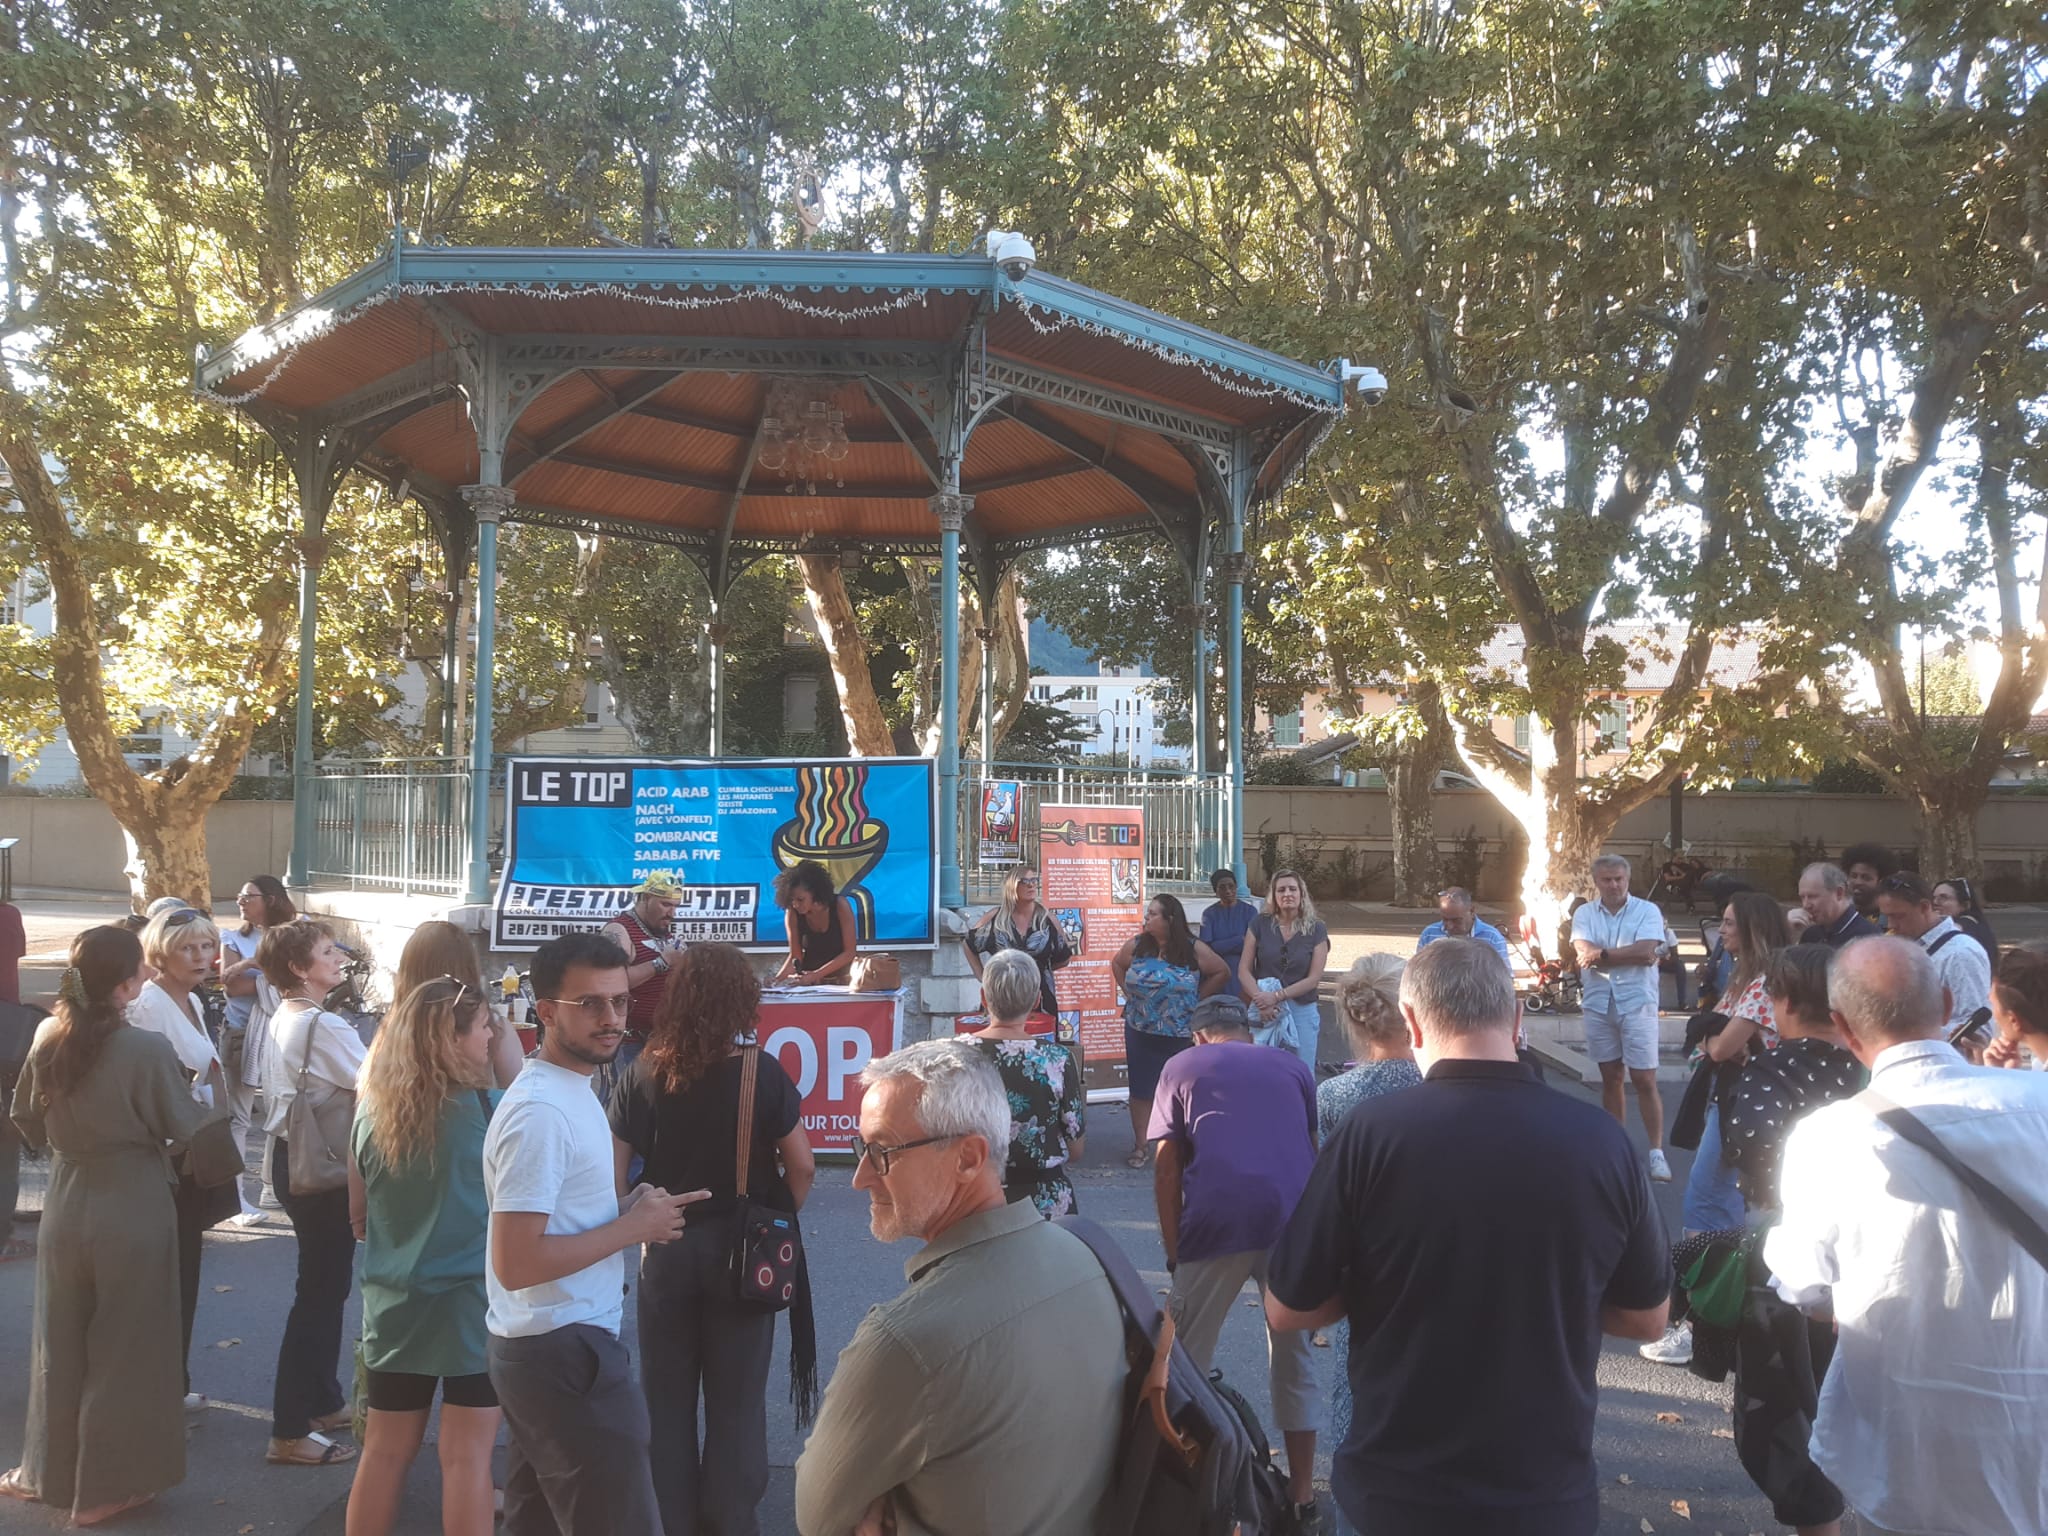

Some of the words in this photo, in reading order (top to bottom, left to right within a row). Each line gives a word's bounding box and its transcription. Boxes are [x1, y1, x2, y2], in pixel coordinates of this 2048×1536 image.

[522, 771, 560, 801] LE
[570, 772, 625, 802] TOP
[636, 786, 667, 798] ACID
[672, 786, 710, 798] ARAB
[635, 804, 674, 815] NACH
[729, 807, 777, 815] AMAZONITA
[635, 816, 664, 826] (AVEC
[666, 815, 713, 826] VONFELT)
[635, 831, 718, 843] DOMBRANCE
[1089, 826, 1106, 843] LE
[1110, 826, 1137, 844] TOP
[633, 850, 688, 861] SABABA
[692, 849, 721, 860] FIVE
[527, 888, 633, 909] FESTIV
[696, 890, 750, 910] TOP
[508, 923, 548, 936] 28/29
[670, 923, 747, 933] E-LES-BAINS
[763, 1026, 873, 1101] OP
